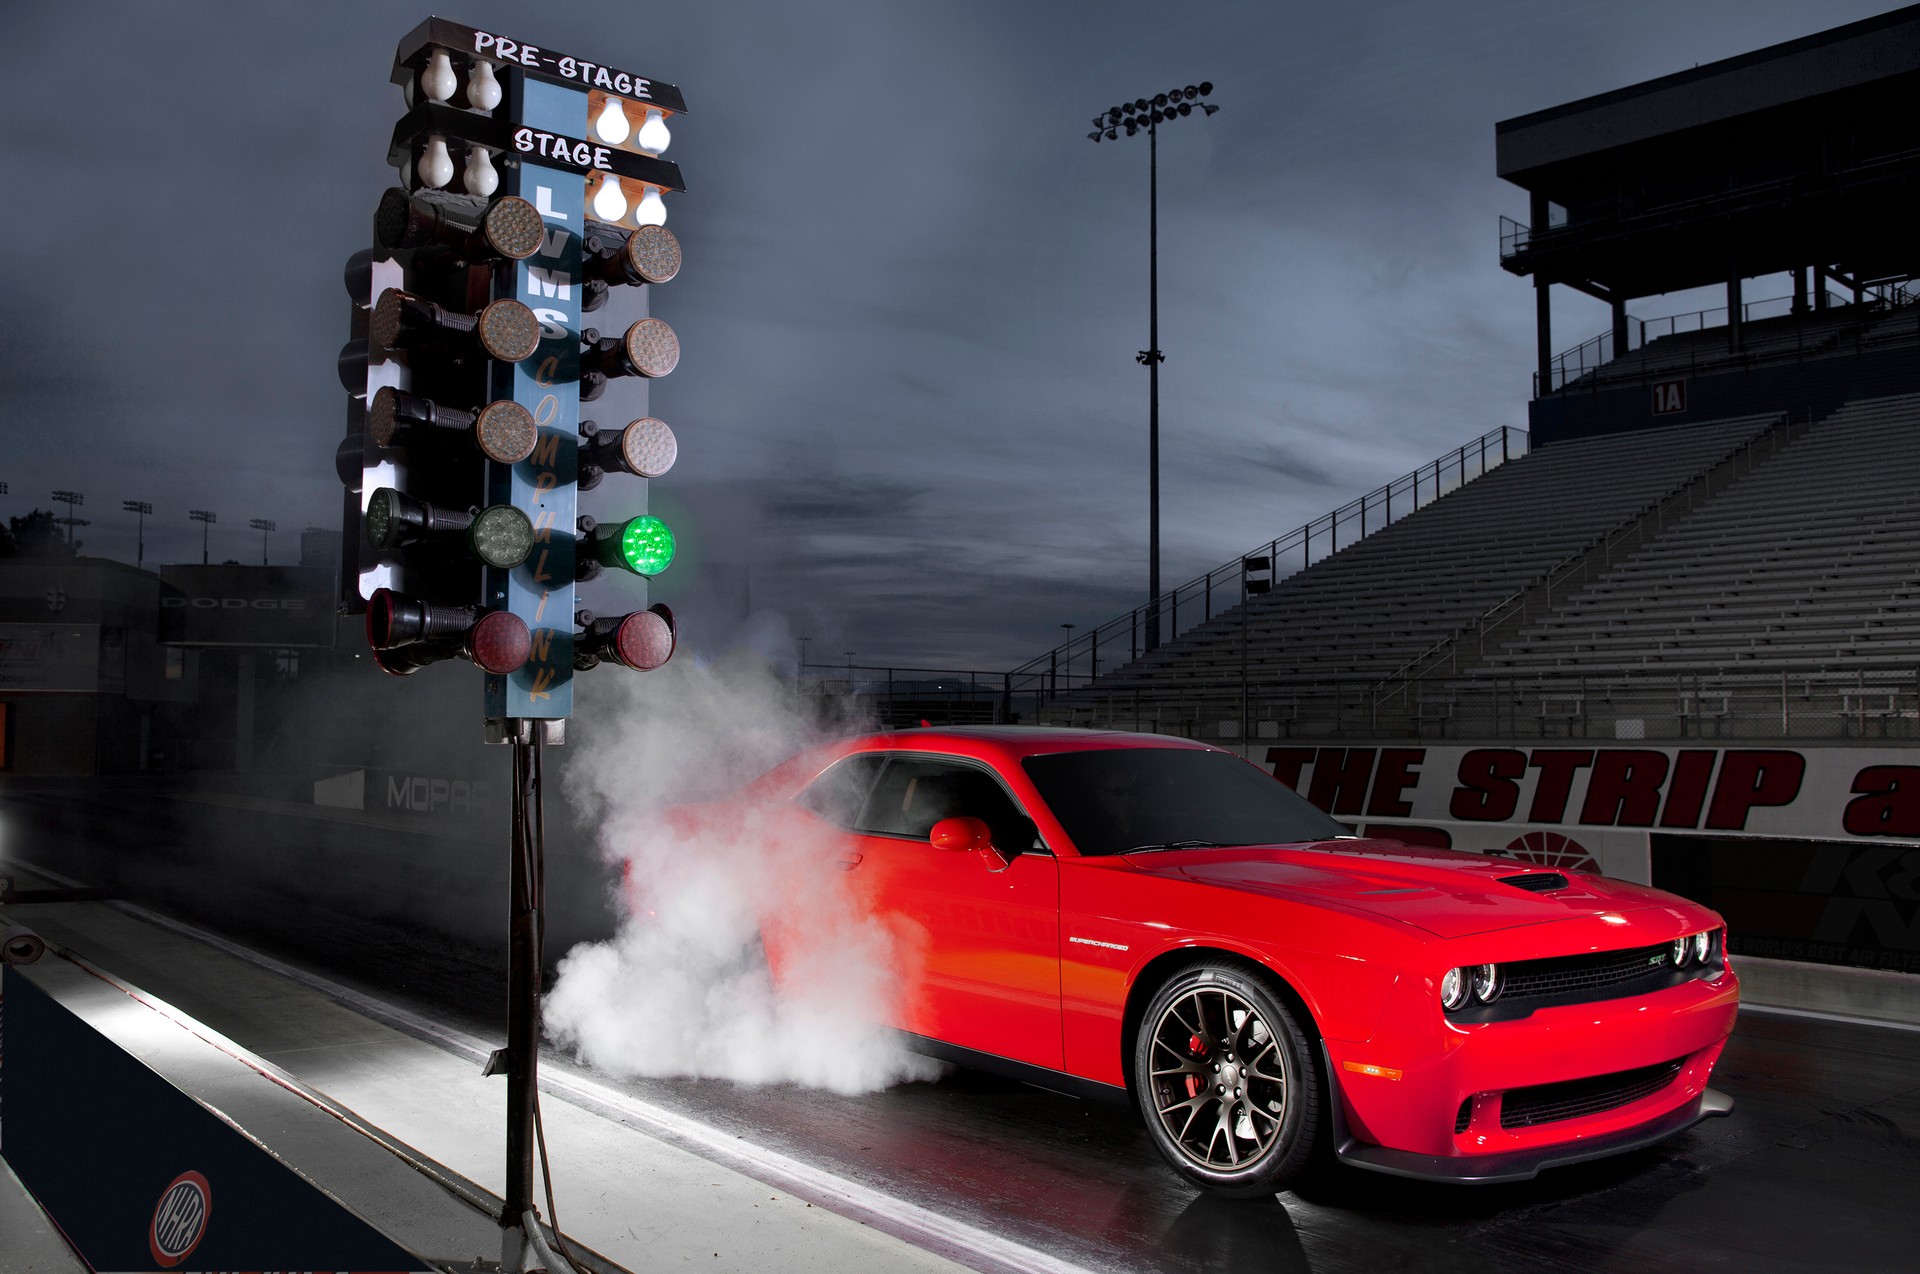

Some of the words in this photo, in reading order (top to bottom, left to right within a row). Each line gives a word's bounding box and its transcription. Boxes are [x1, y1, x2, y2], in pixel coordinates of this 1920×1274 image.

[474, 30, 653, 100] PRE-STAGE
[513, 127, 613, 170] STAGE
[527, 185, 572, 340] LVMS
[1655, 383, 1681, 412] 1A
[161, 597, 305, 609] DODGE
[1265, 747, 1426, 817] THE
[1449, 749, 1807, 830] STRIP
[1069, 936, 1129, 951] SUPERCHARGED
[1743, 937, 1804, 955] WORLD'S
[1808, 944, 1847, 960] BEST
[1848, 948, 1875, 964] AIR
[158, 1186, 203, 1250] NHRA
